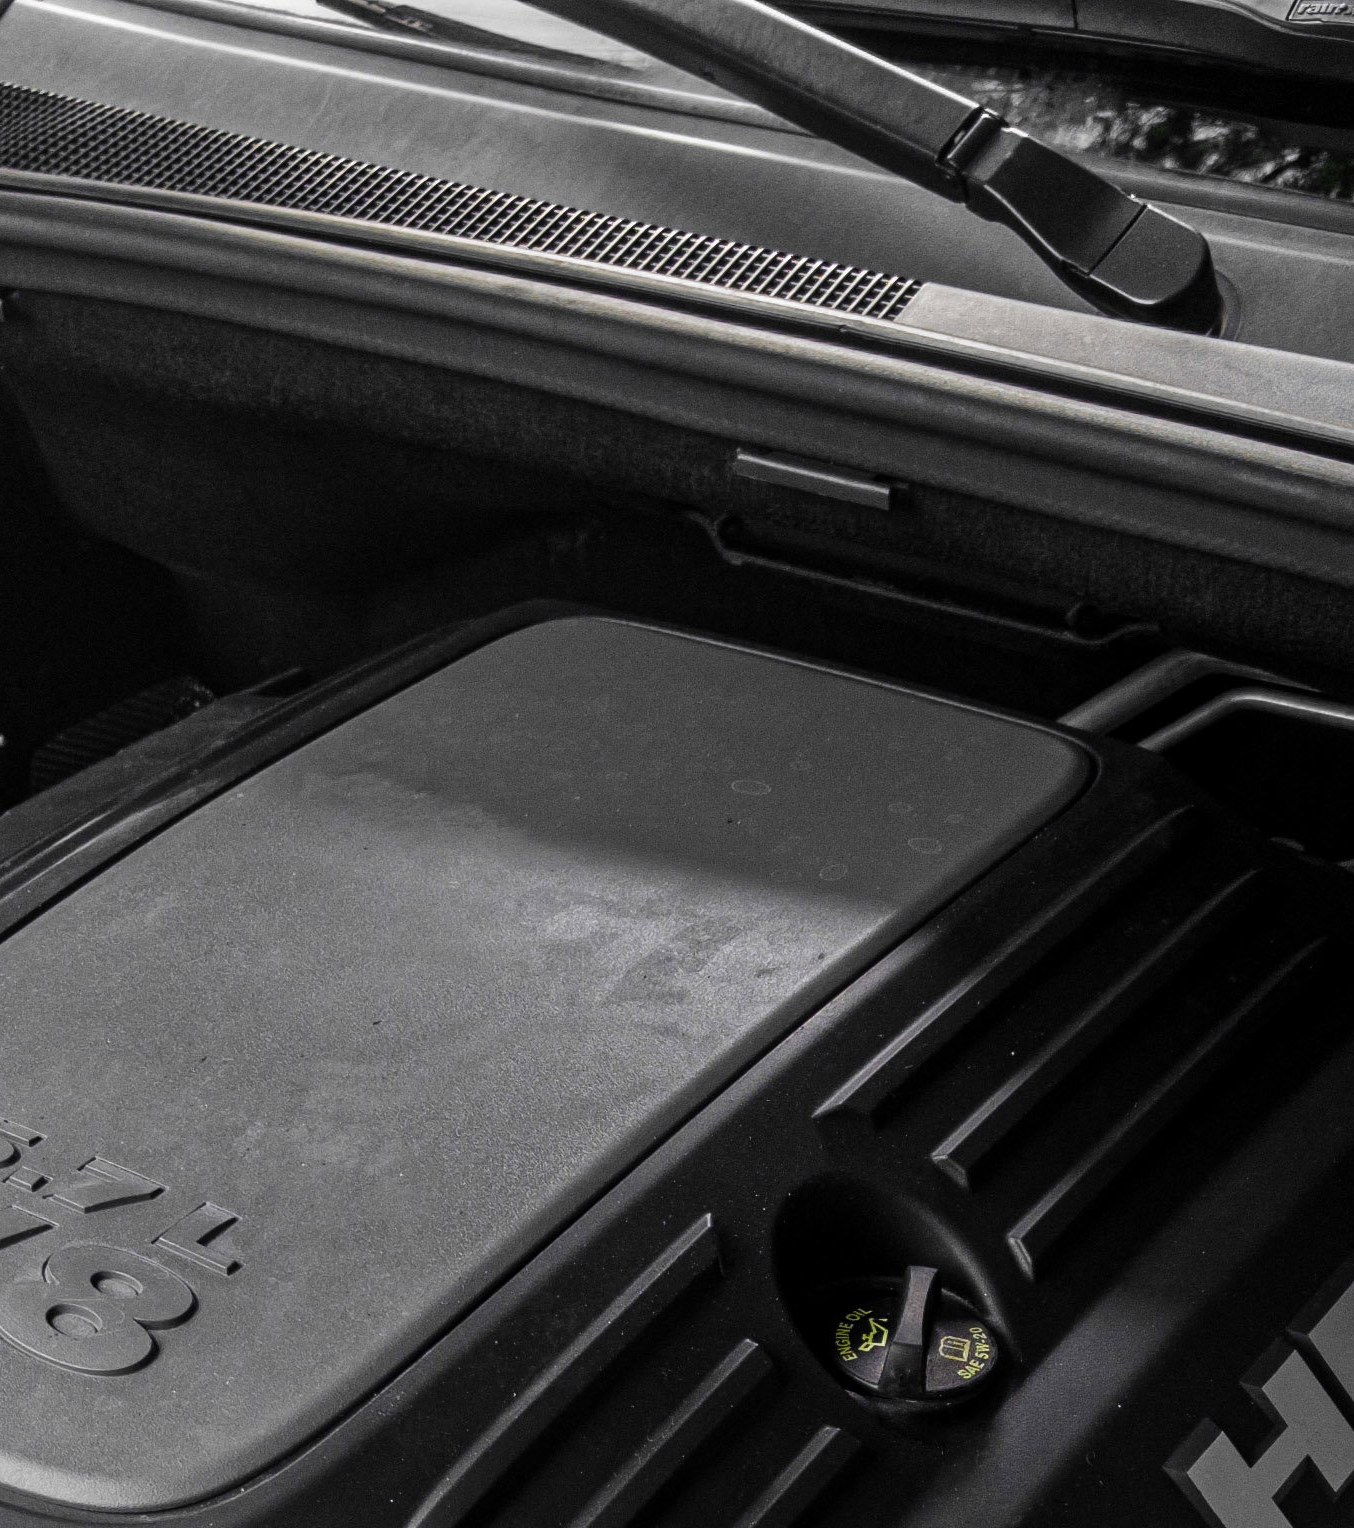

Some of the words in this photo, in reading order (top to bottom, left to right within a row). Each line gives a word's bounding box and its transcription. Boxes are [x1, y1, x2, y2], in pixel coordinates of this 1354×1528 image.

[845, 1307, 873, 1322] OIL
[835, 1321, 859, 1362] ENGINE
[968, 1326, 991, 1360] 5W-20
[956, 1358, 986, 1380] SAE
